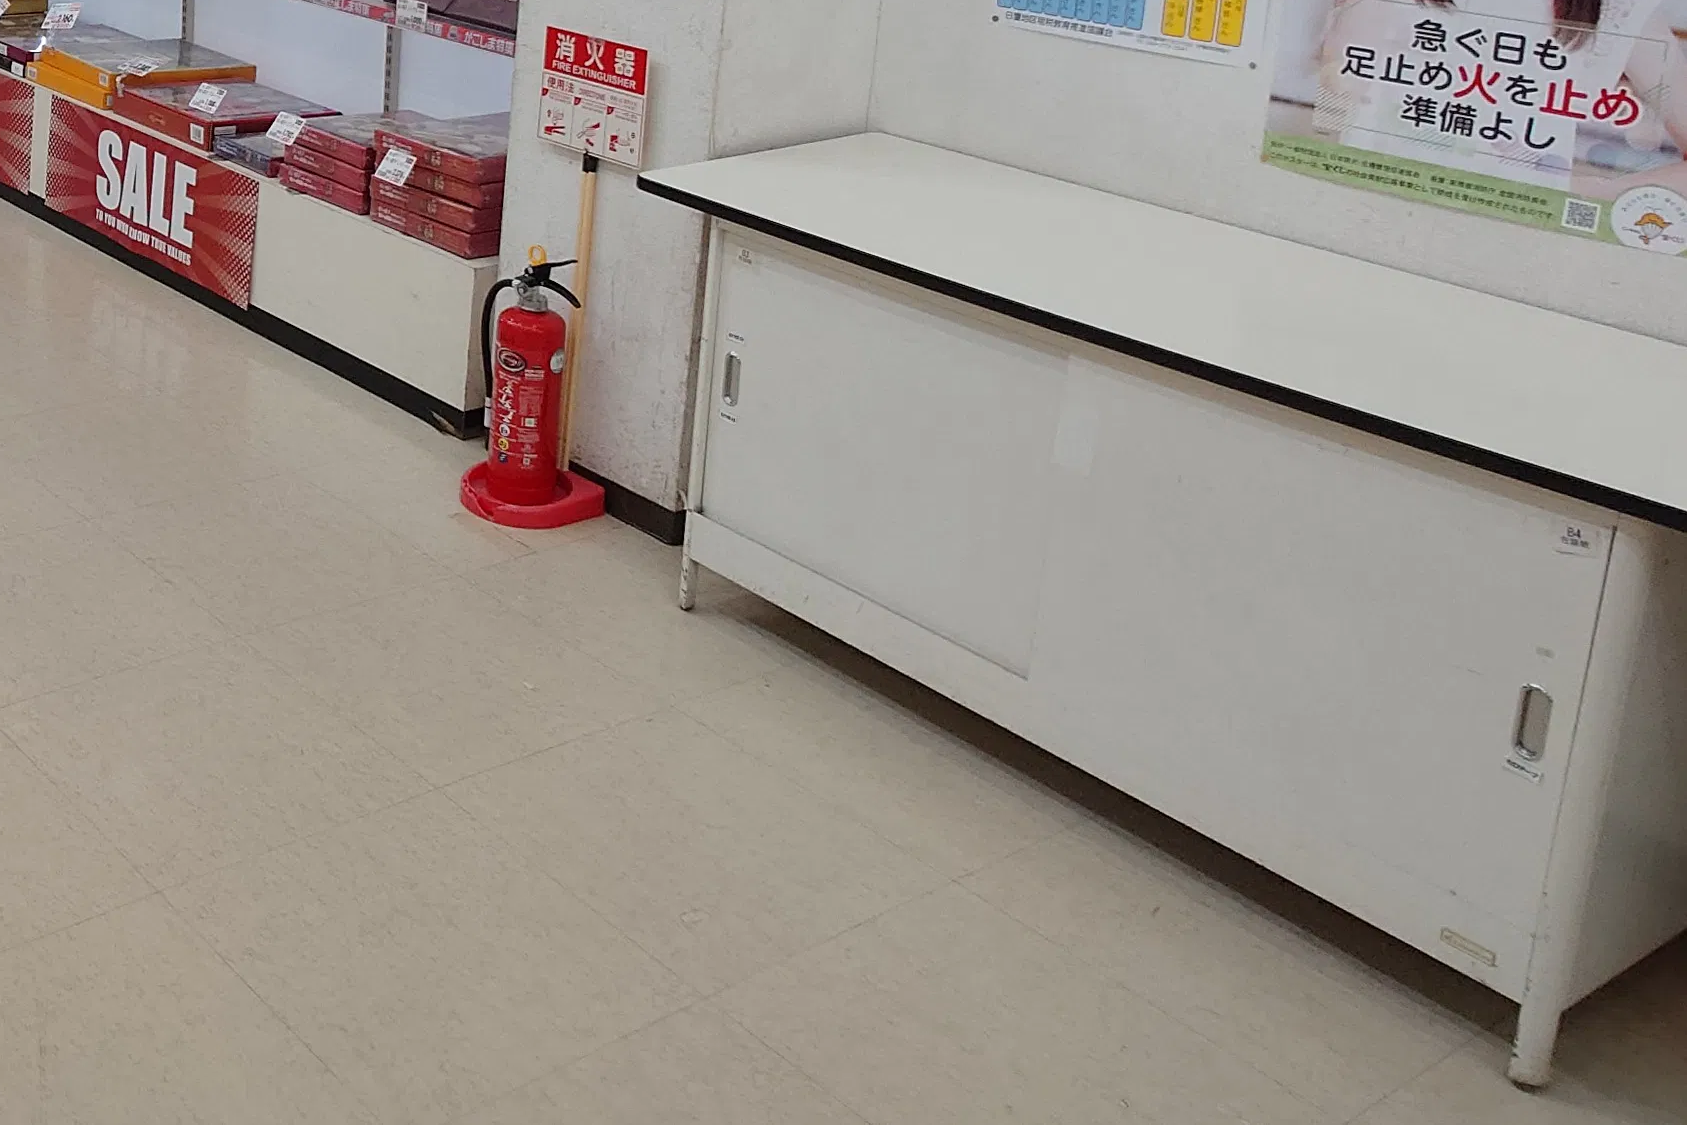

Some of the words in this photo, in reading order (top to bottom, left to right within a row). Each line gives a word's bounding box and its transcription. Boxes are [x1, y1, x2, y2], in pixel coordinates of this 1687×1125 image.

[555, 32, 635, 77] 消火器
[1412, 20, 1567, 70] 急ぐ日も
[552, 60, 571, 73] FIRE
[572, 65, 636, 90] EXTINGUISHER
[1341, 45, 1639, 126] 足止め火を止め
[1401, 94, 1555, 149] 準備よし
[96, 129, 197, 249] SALE
[96, 208, 103, 221] TO
[104, 213, 115, 228] YOU
